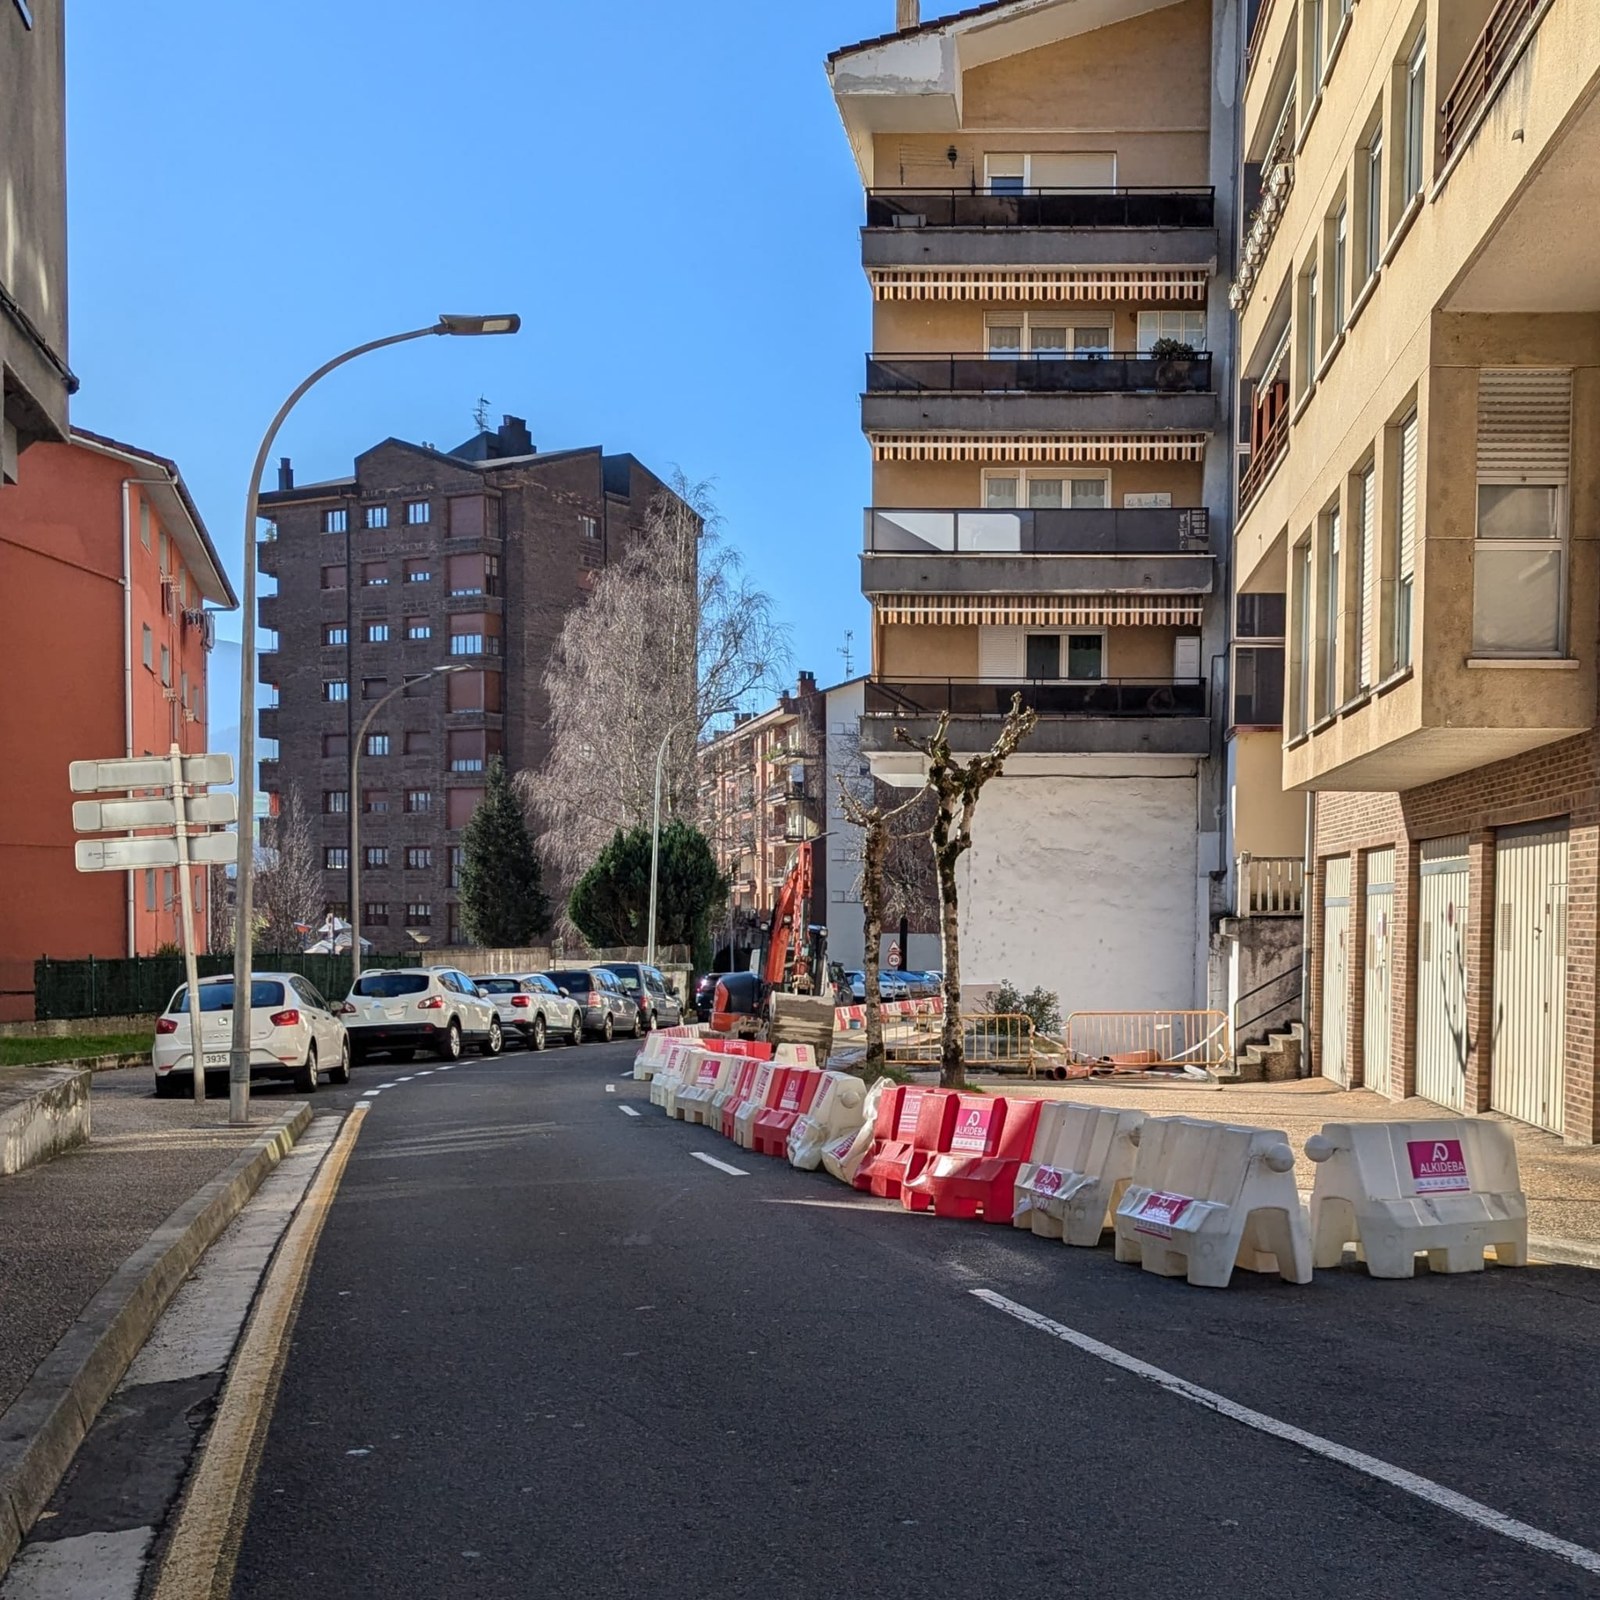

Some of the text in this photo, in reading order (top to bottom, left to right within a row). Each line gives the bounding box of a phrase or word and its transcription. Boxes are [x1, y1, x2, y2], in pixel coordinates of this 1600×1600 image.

[205, 1054, 227, 1064] 3935
[954, 1126, 987, 1137] ALKIDEBA
[1420, 1161, 1466, 1173] ALKIDEBA
